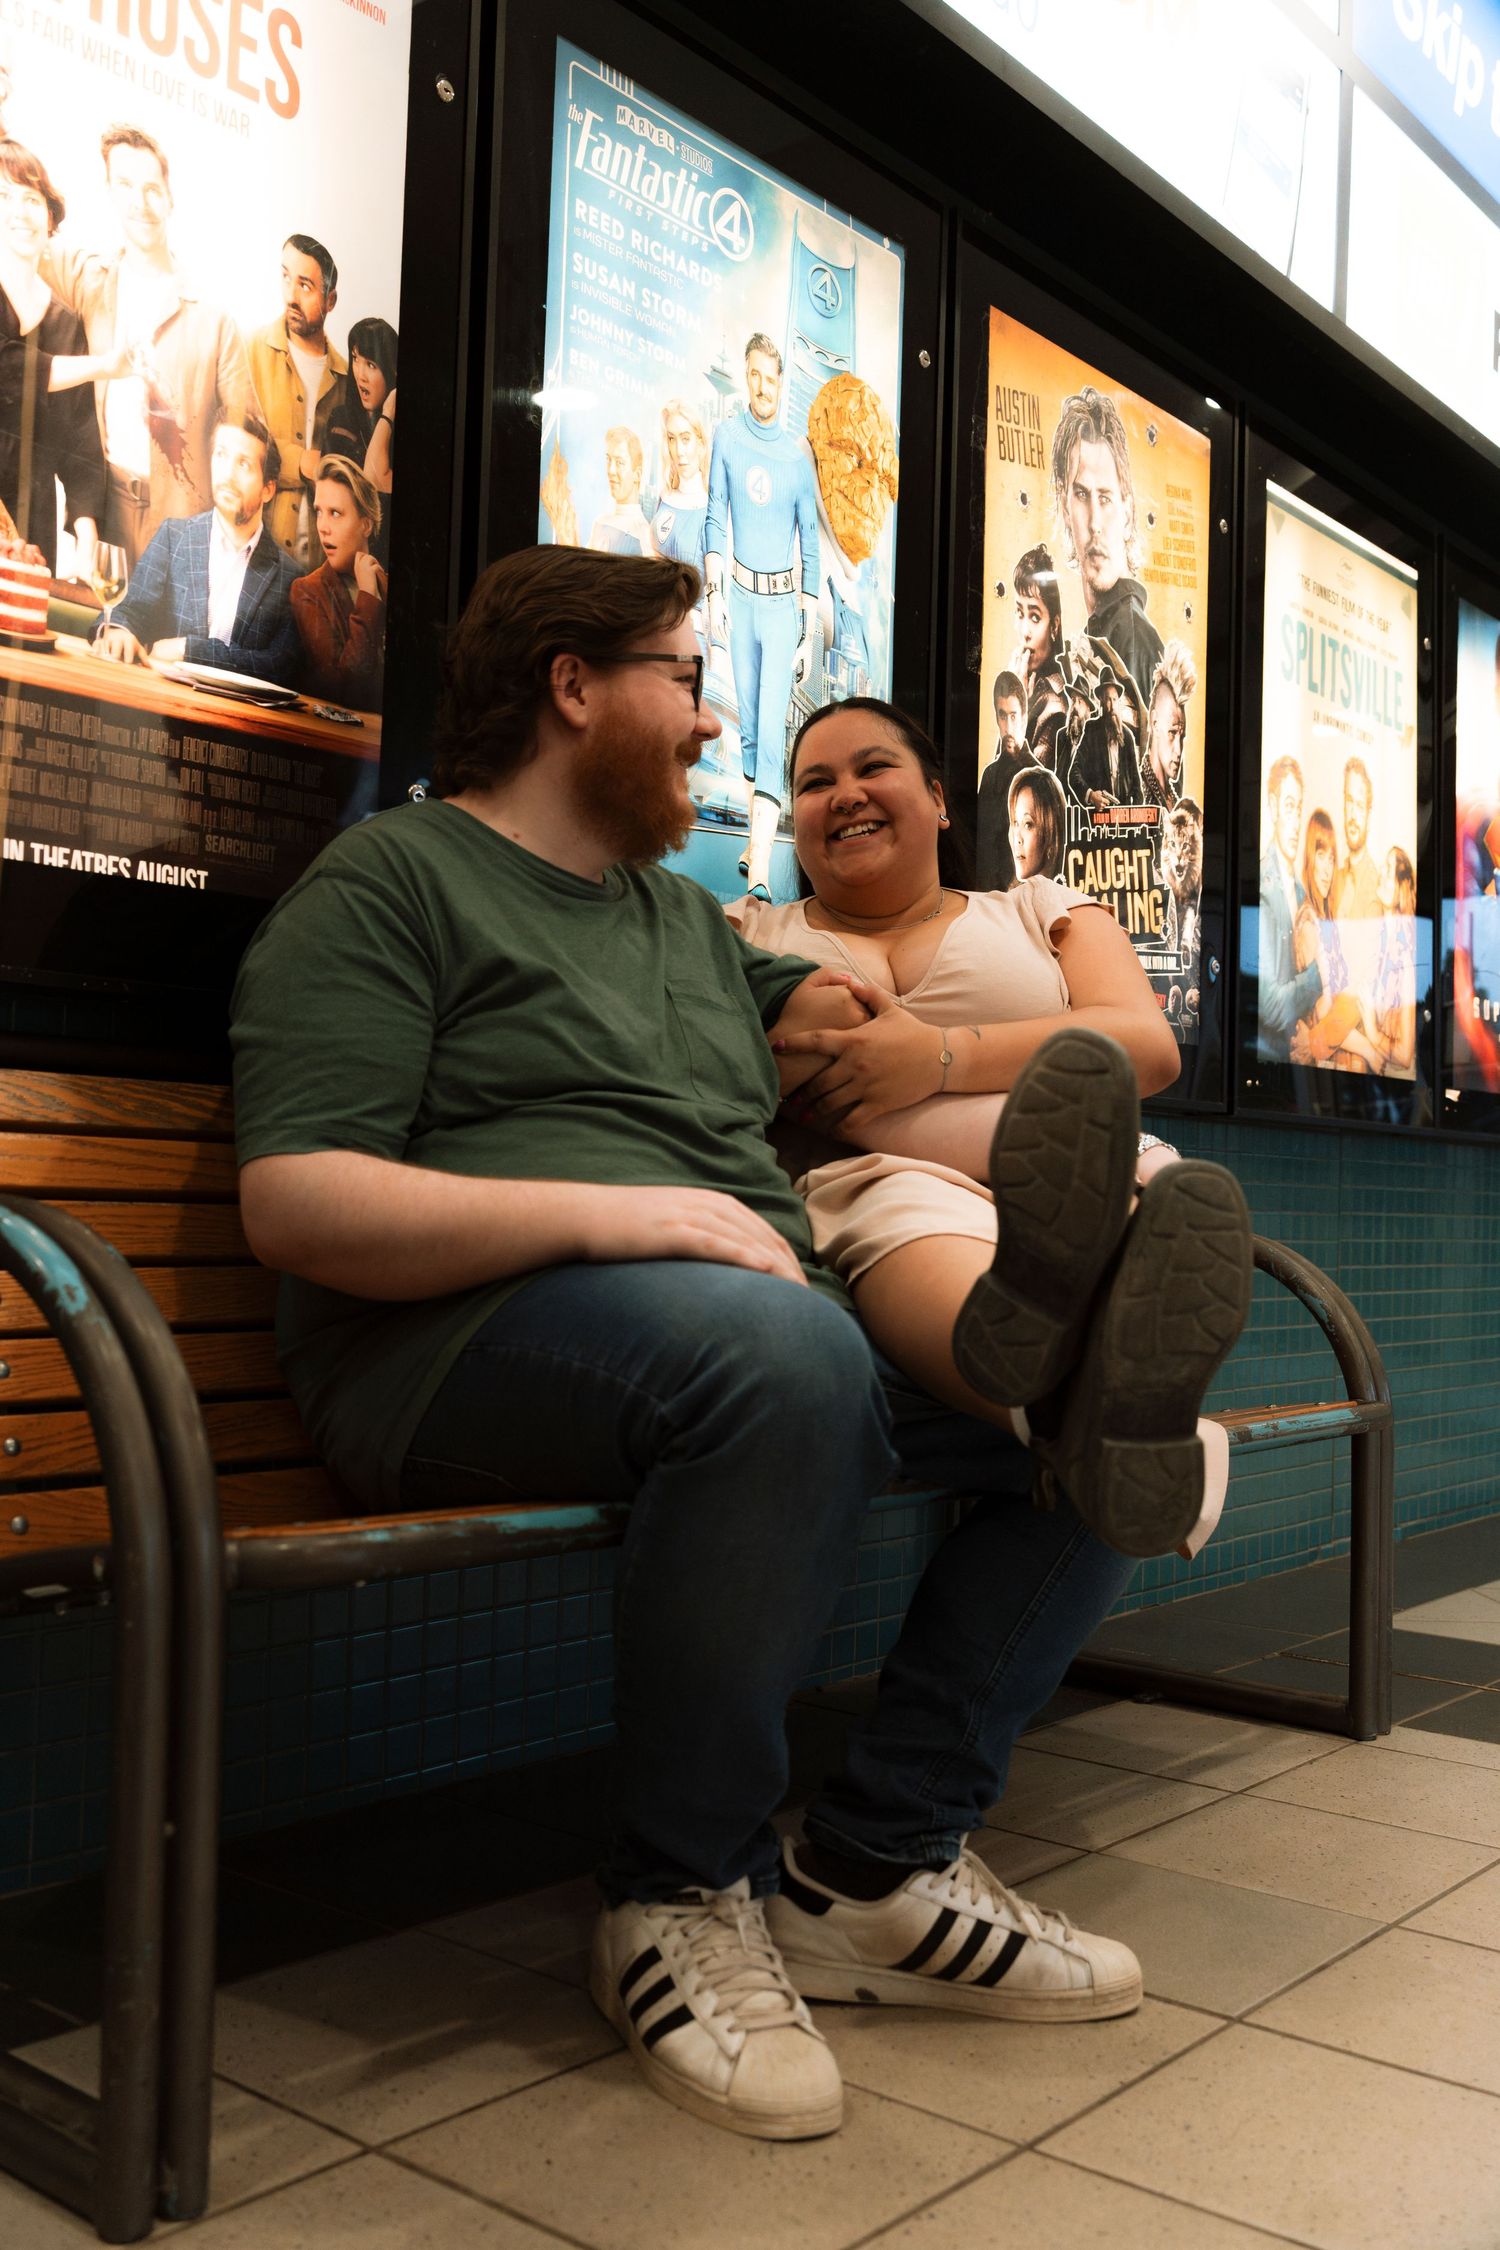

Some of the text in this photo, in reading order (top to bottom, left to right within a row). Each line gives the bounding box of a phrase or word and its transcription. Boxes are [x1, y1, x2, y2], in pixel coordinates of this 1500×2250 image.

[32, 9, 75, 54] FAIR
[82, 35, 137, 84] WHEN
[142, 63, 186, 108] LOVE
[192, 88, 208, 118] IS
[213, 99, 251, 139] WAR
[568, 103, 583, 125] the
[617, 106, 713, 175] MARVEL STUDIOS
[574, 107, 711, 230] Fantastic
[574, 197, 723, 294] REED RICHARDS
[608, 188, 709, 253] FIRST STEPS
[582, 228, 623, 258] MISTER
[625, 251, 685, 291] FANTASTIC
[572, 251, 703, 334] SUSAN STORM
[580, 280, 633, 317] INVISIBLE
[635, 308, 673, 336] WOMAN
[569, 303, 687, 370] JOHNNY STORM
[569, 347, 599, 376] BEN
[995, 384, 1041, 431] AUSTIN
[997, 424, 1045, 470] BUTLER
[1281, 614, 1404, 732] SPLITSVILLE
[3, 838, 24, 861] IN
[30, 842, 131, 878] THEATRES
[136, 860, 209, 889] AUGUST
[204, 834, 277, 863] SEARCHLIGHT
[1068, 847, 1151, 895] CAUGHT
